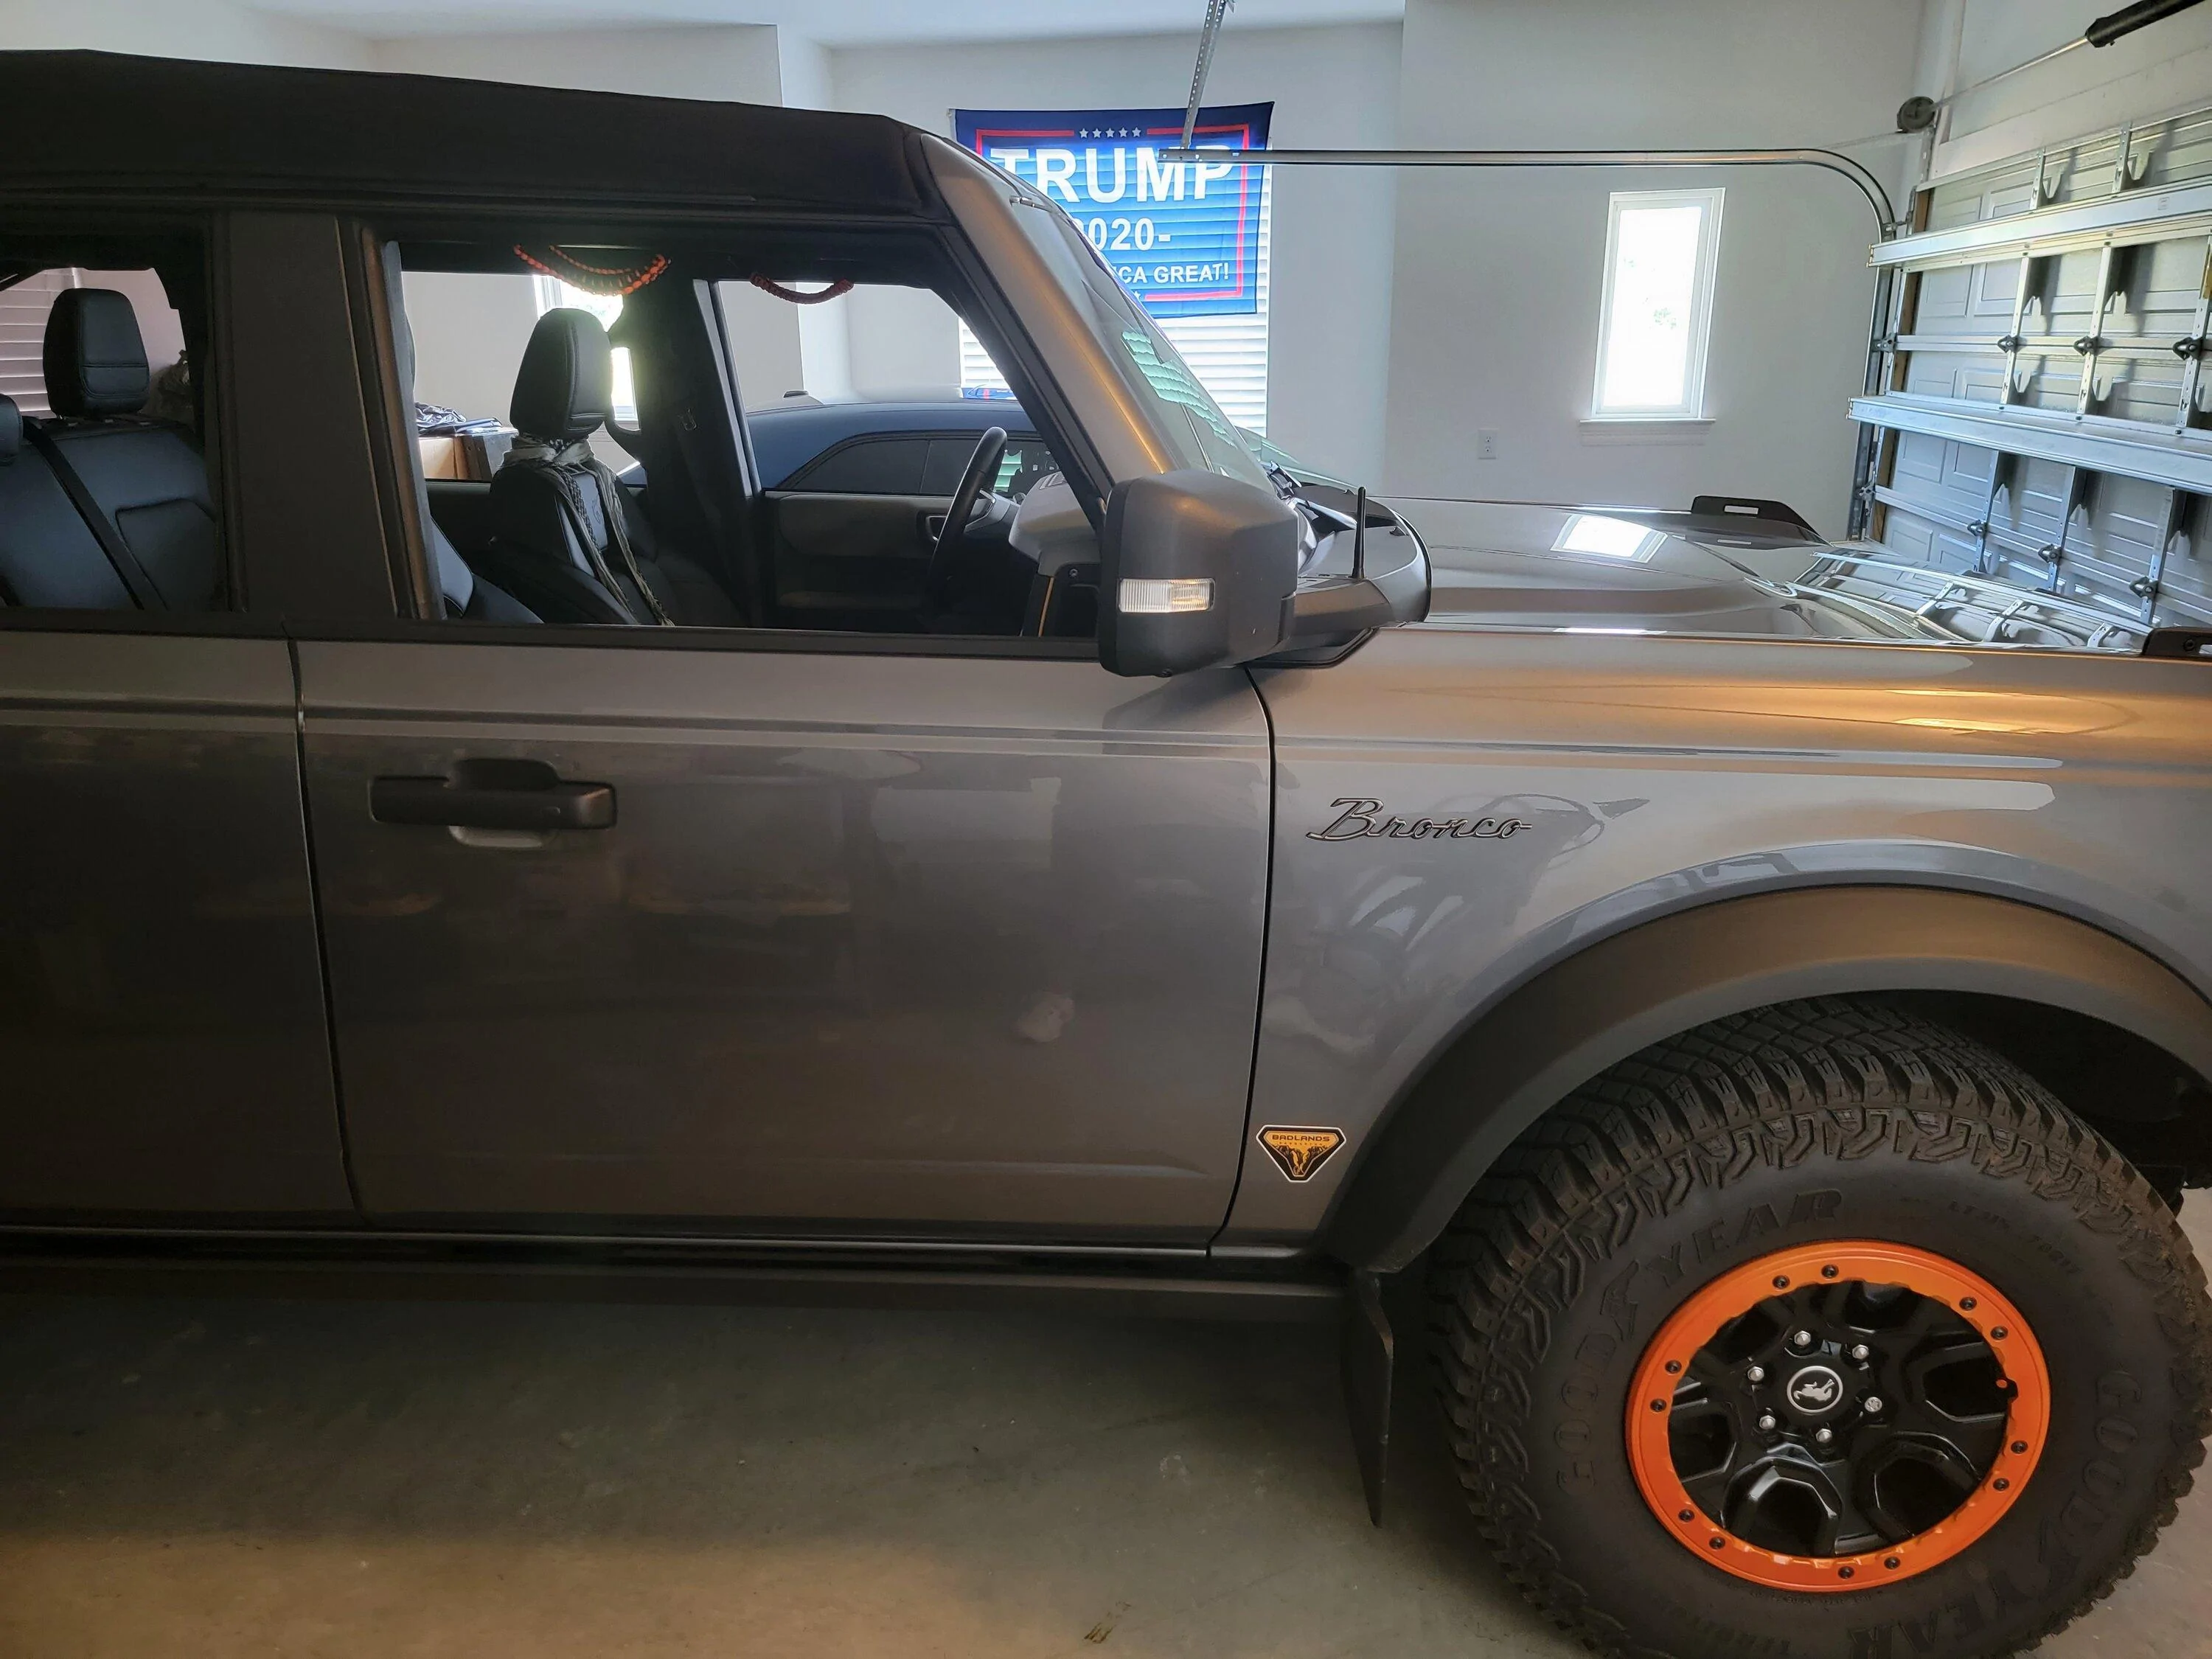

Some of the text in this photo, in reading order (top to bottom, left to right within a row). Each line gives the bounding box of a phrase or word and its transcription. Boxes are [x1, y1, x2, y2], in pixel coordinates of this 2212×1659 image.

[990, 145, 1234, 204] TRUMP
[1153, 262, 1230, 284] GREAT!
[1306, 797, 1533, 842] Bronco
[1272, 1134, 1330, 1142] BADLANDS
